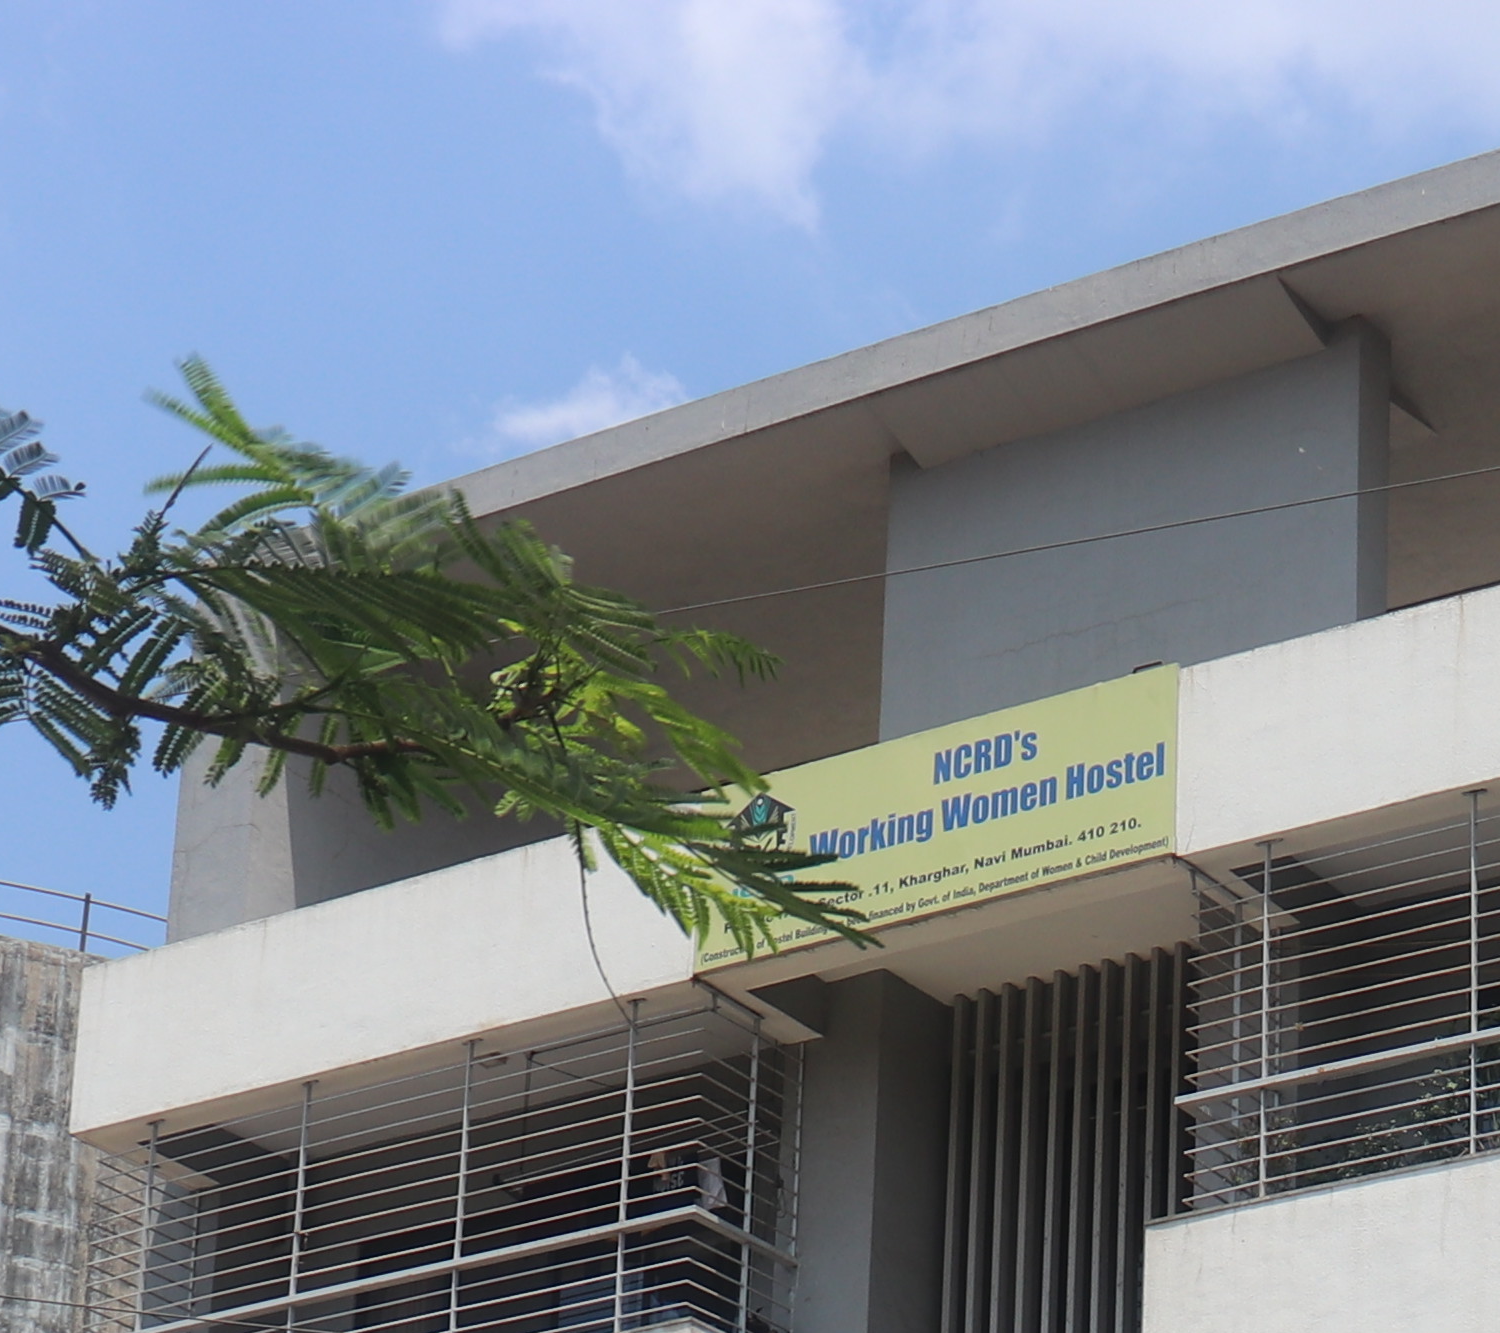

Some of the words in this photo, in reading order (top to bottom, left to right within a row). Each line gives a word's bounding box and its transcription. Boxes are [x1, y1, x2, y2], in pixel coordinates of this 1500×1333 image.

[809, 808, 934, 860] Working
[941, 777, 1057, 833] Women
[1066, 742, 1166, 800] Hostel
[933, 730, 1038, 785] NCRD's
[773, 930, 793, 943] ostel
[869, 904, 903, 920] financed
[906, 901, 916, 913] by
[918, 894, 940, 909] Govt.
[978, 872, 1029, 893] Department
[1031, 867, 1040, 880] of
[1042, 860, 1073, 877] Women
[1076, 857, 1082, 868] &
[1084, 849, 1107, 866] Child
[1109, 836, 1169, 861] Development)
[899, 863, 969, 889] Kharghar,
[974, 851, 1006, 870] Navi
[1011, 836, 1072, 860] Mumbai.
[1077, 825, 1105, 842] 410
[1109, 817, 1142, 836] 210.
